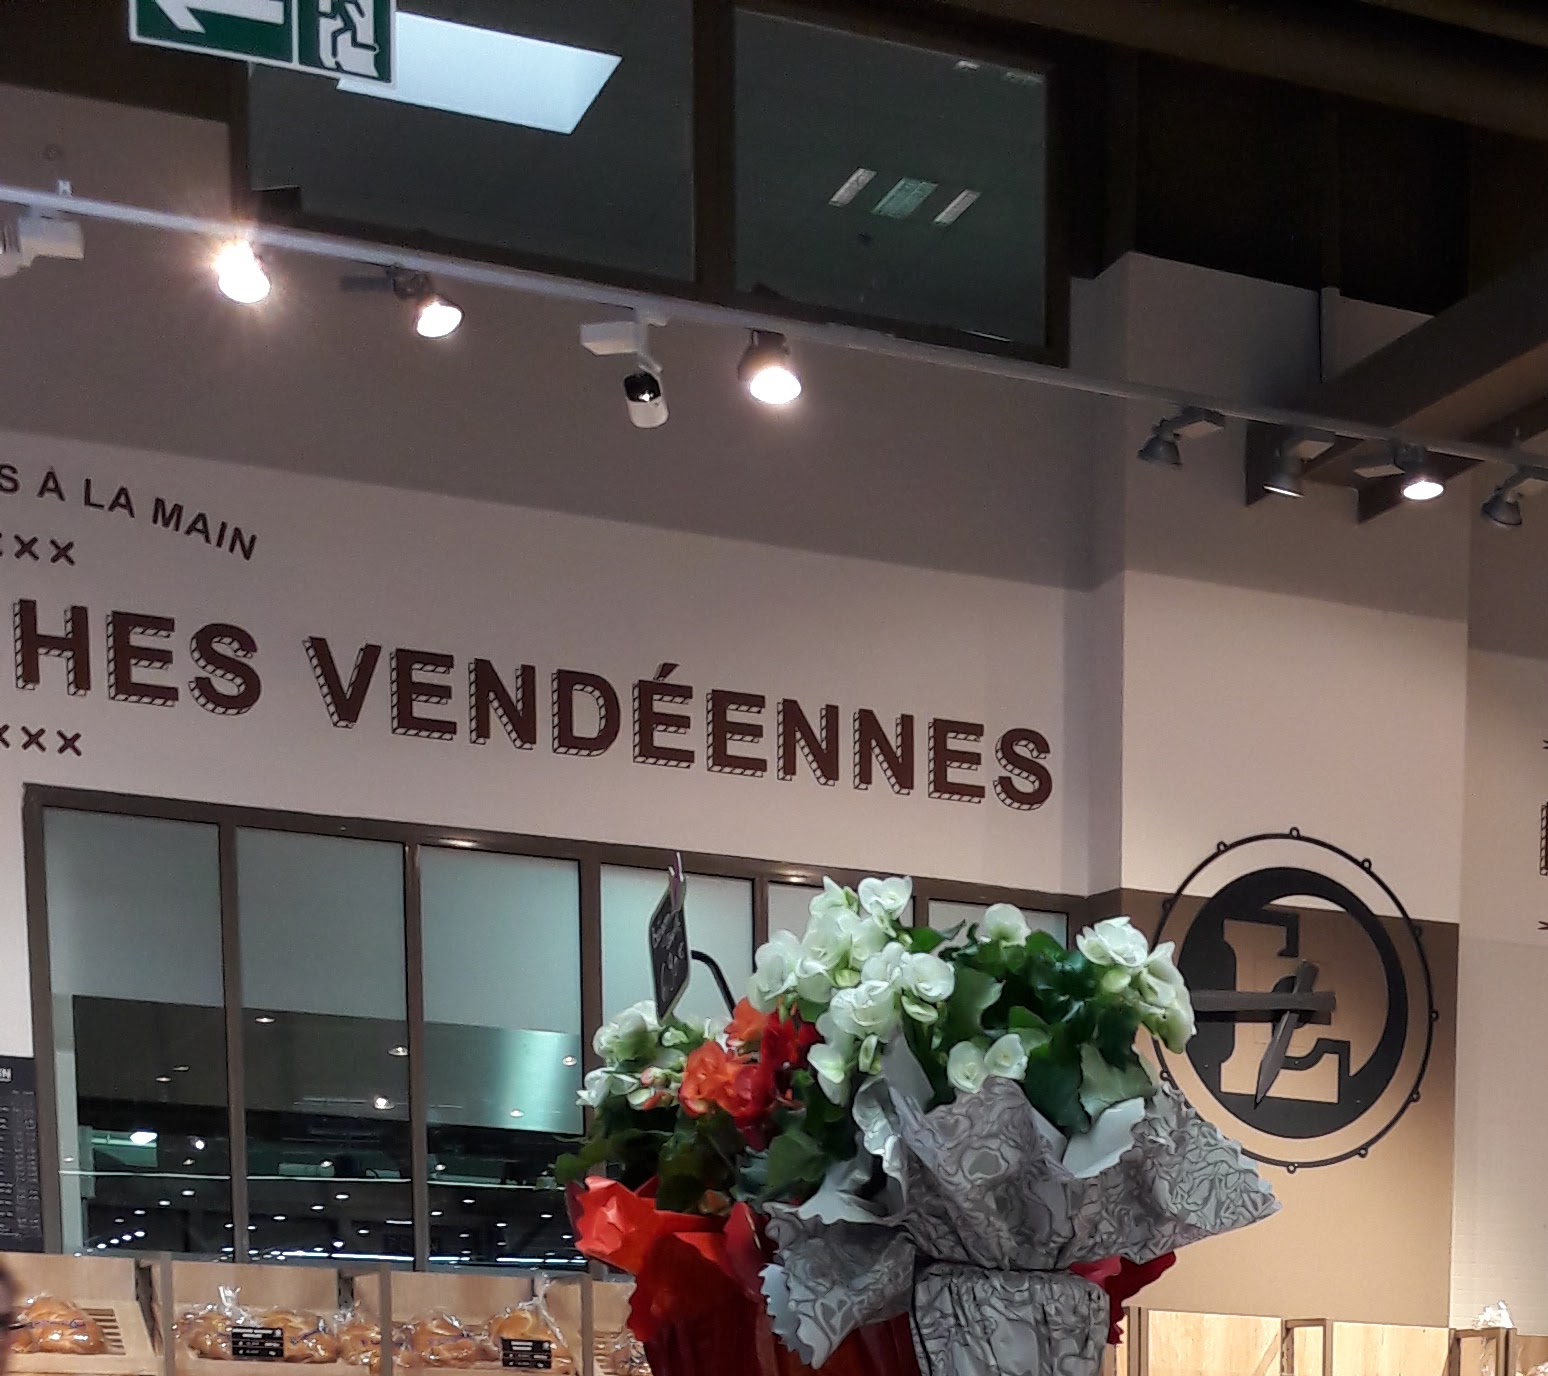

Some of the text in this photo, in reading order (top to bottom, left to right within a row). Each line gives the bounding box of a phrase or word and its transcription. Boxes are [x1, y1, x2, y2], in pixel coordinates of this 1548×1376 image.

[84, 477, 136, 519] LA
[152, 497, 258, 562] MAIN
[13, 599, 1053, 812] HES VENDÉENNES
